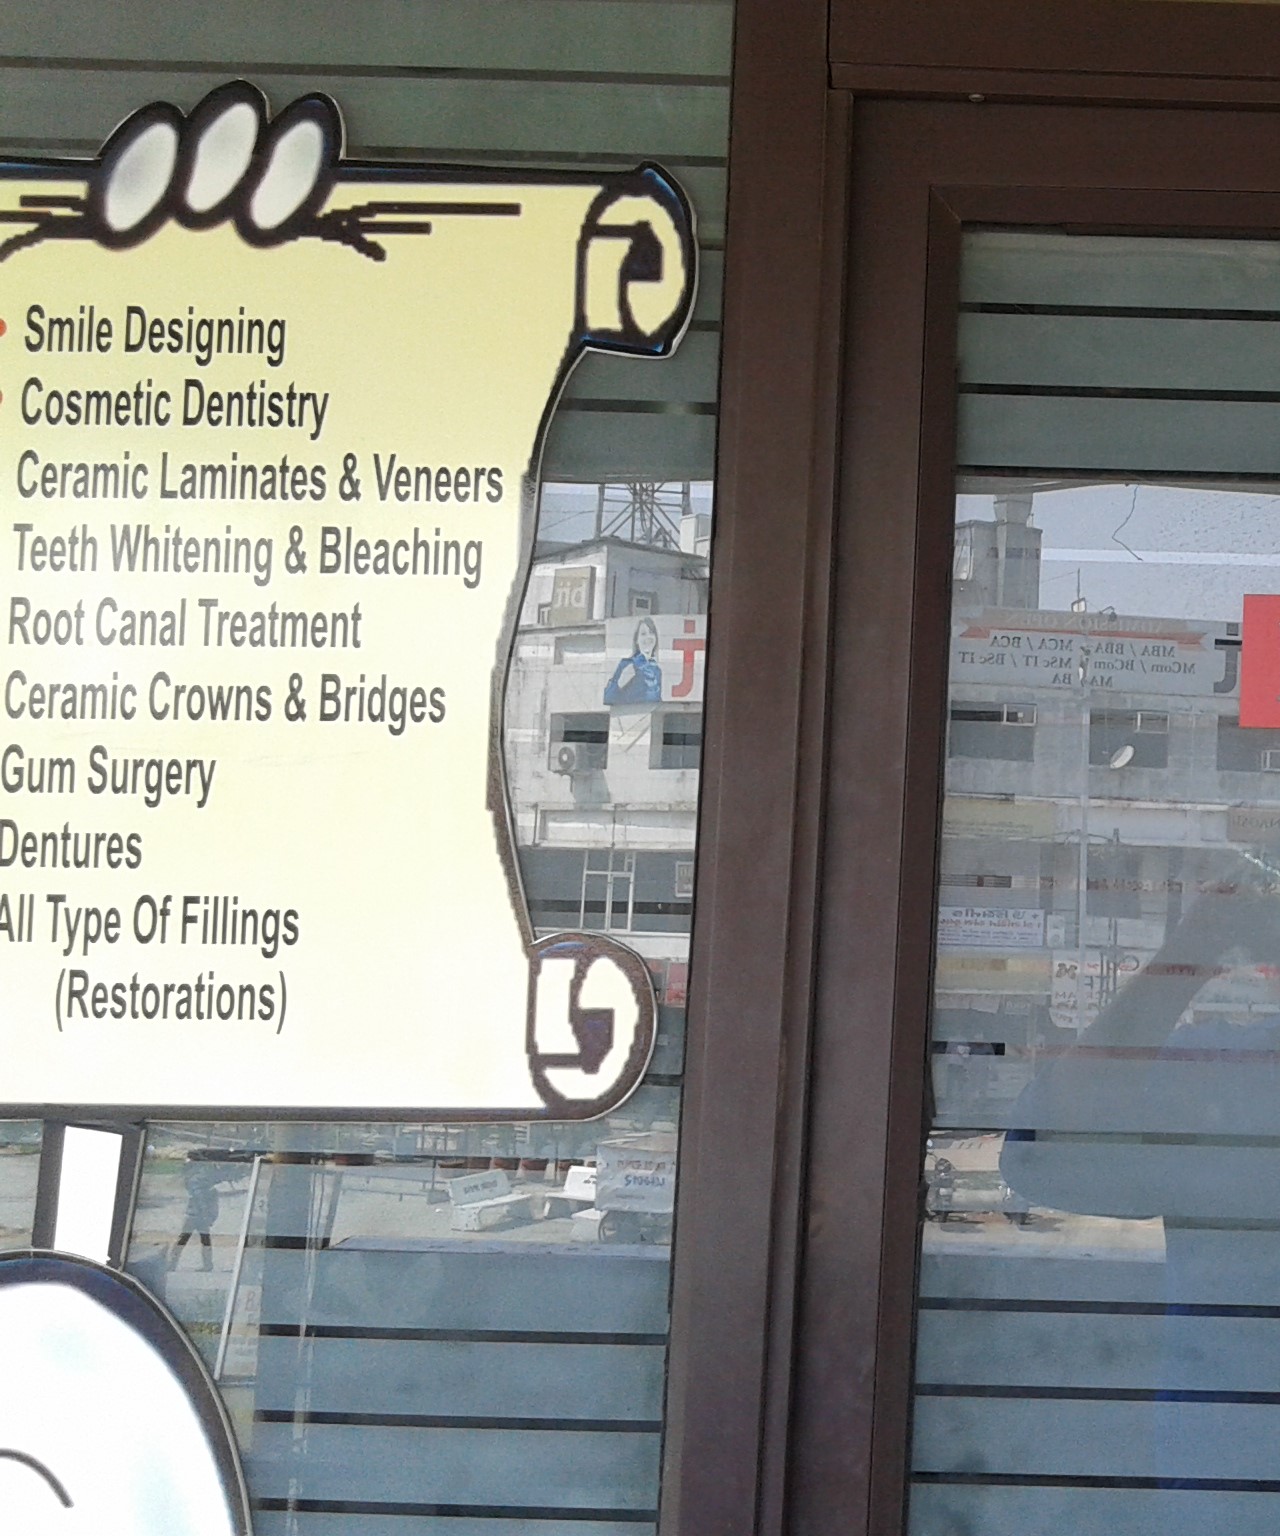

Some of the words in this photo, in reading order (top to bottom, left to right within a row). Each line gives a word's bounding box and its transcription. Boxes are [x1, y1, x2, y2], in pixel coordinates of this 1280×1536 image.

[24, 304, 113, 353] Smile
[124, 305, 286, 368] Designing
[21, 376, 172, 427] Cosmetic
[182, 378, 330, 441] Dentistry
[16, 449, 149, 500] Ceramic
[159, 451, 327, 501] Laminates
[338, 452, 362, 502] &
[372, 452, 504, 503] Veneers
[13, 523, 98, 572] Teeth
[110, 524, 273, 587] Whitening
[284, 525, 307, 575] &
[319, 525, 483, 589] Bleaching
[8, 596, 85, 646] Root
[95, 596, 187, 647] Canal
[197, 598, 362, 649] Treatment
[4, 670, 137, 721] Ceramic
[148, 671, 272, 722] Crowns
[284, 674, 307, 722] &
[319, 674, 446, 737] Bridges
[1, 743, 76, 794] Gum
[87, 744, 217, 809] Surgery
[0, 818, 143, 870] Dentures
[0, 893, 35, 943] All
[45, 895, 121, 957] Type
[133, 895, 173, 945] Of
[180, 895, 299, 959] Fillings
[55, 968, 287, 1035] (Restorations)
